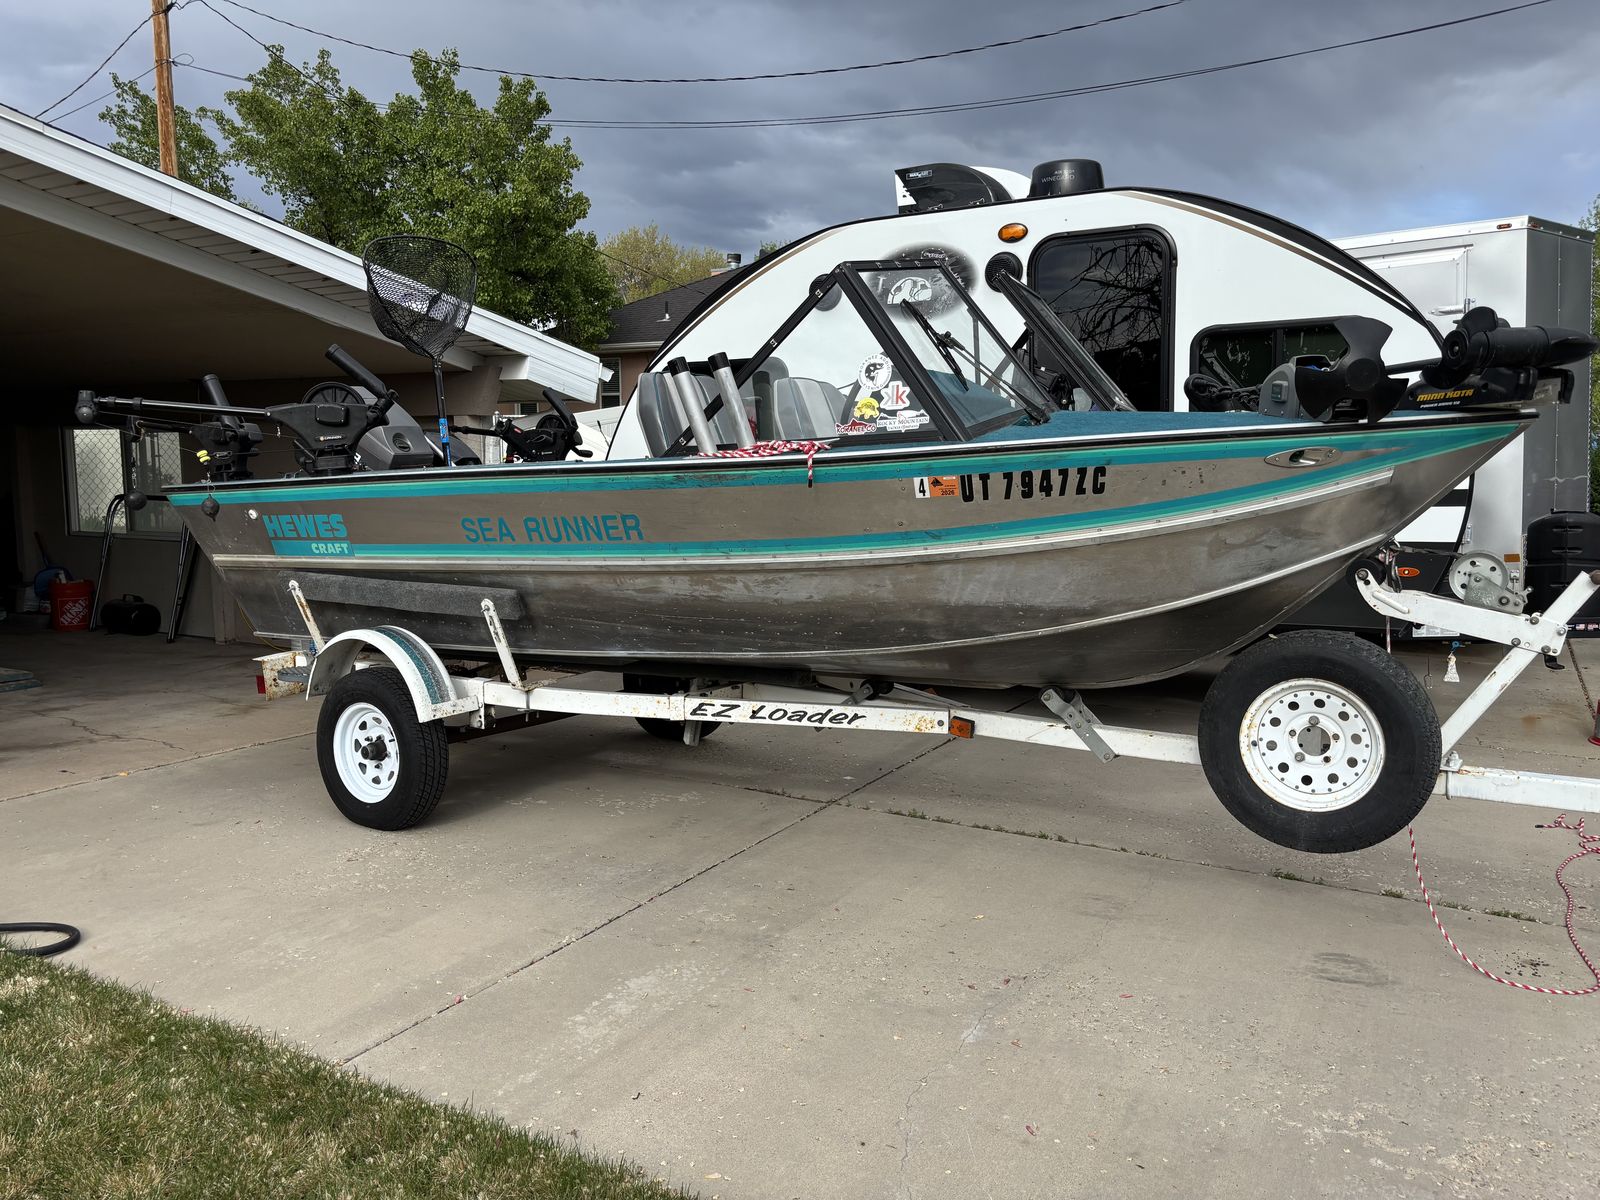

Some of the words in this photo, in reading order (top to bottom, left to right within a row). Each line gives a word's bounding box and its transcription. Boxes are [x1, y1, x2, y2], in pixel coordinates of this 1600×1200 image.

[1416, 392, 1446, 402] MINN
[1446, 388, 1475, 399] KOTA
[918, 478, 926, 497] 4
[959, 473, 991, 503] UT
[262, 513, 348, 538] HEWES
[460, 516, 516, 543] SEA
[522, 513, 644, 543] RUNNER
[311, 543, 349, 554] CRAFT
[60, 598, 88, 625] HOME
[689, 702, 741, 718] EZ
[749, 704, 867, 725] Loader
